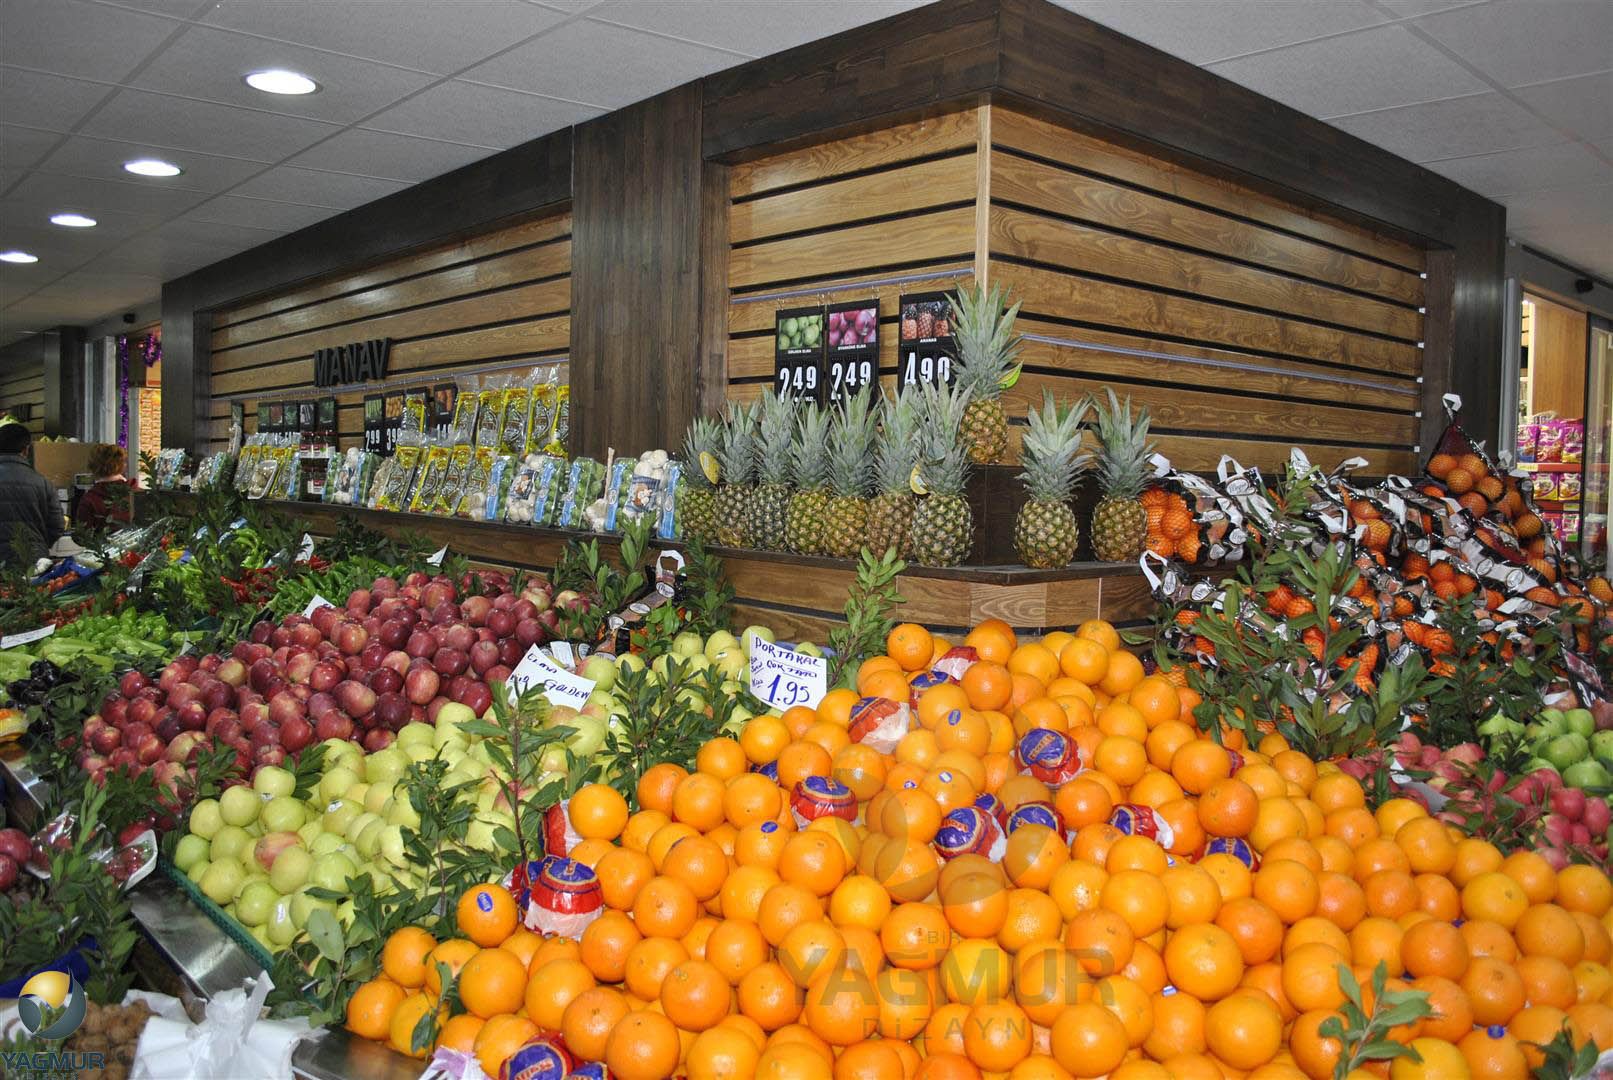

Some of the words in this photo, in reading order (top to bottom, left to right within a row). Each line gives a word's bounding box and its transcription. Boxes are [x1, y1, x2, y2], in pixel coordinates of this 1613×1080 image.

[314, 337, 392, 387] MANAV
[831, 361, 872, 399] 249
[779, 365, 817, 403] 249
[767, 674, 810, 706] 1.95
